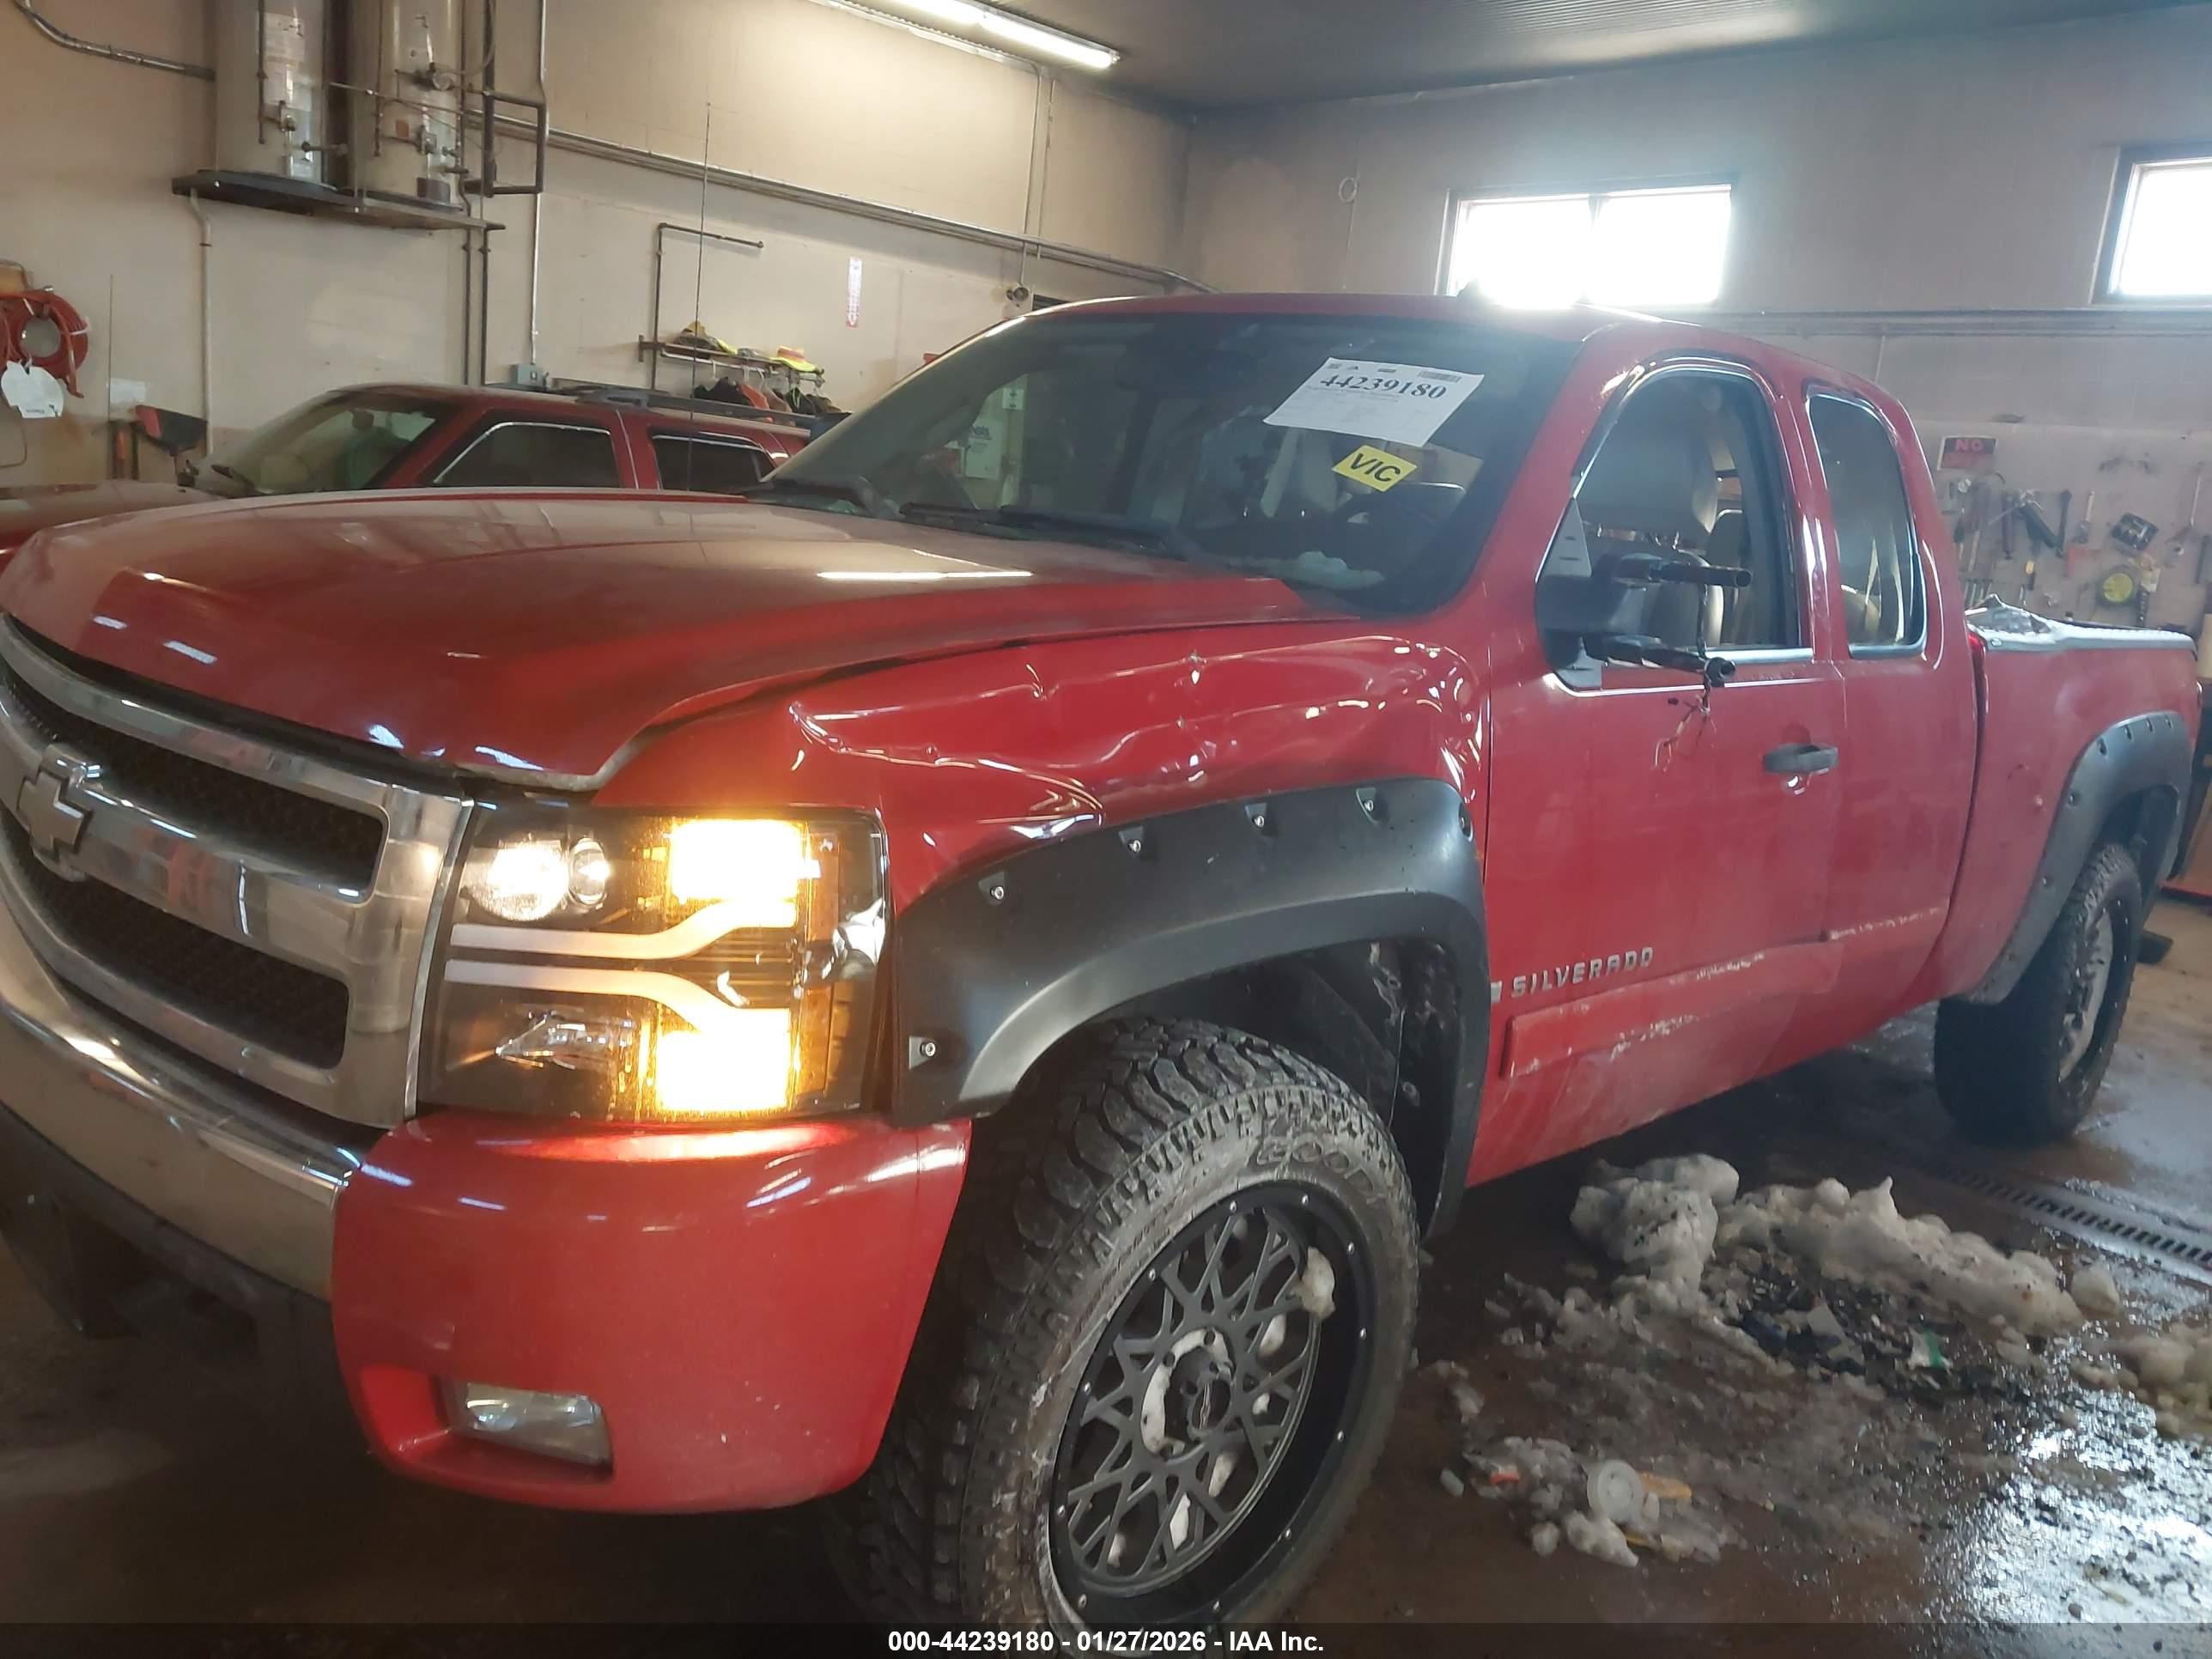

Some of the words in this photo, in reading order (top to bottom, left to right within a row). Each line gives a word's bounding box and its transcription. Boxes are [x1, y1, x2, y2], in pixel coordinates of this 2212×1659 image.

[1321, 374, 1447, 399] 44239180
[1351, 453, 1401, 482] VIC
[1511, 947, 1654, 997] SILVERADO
